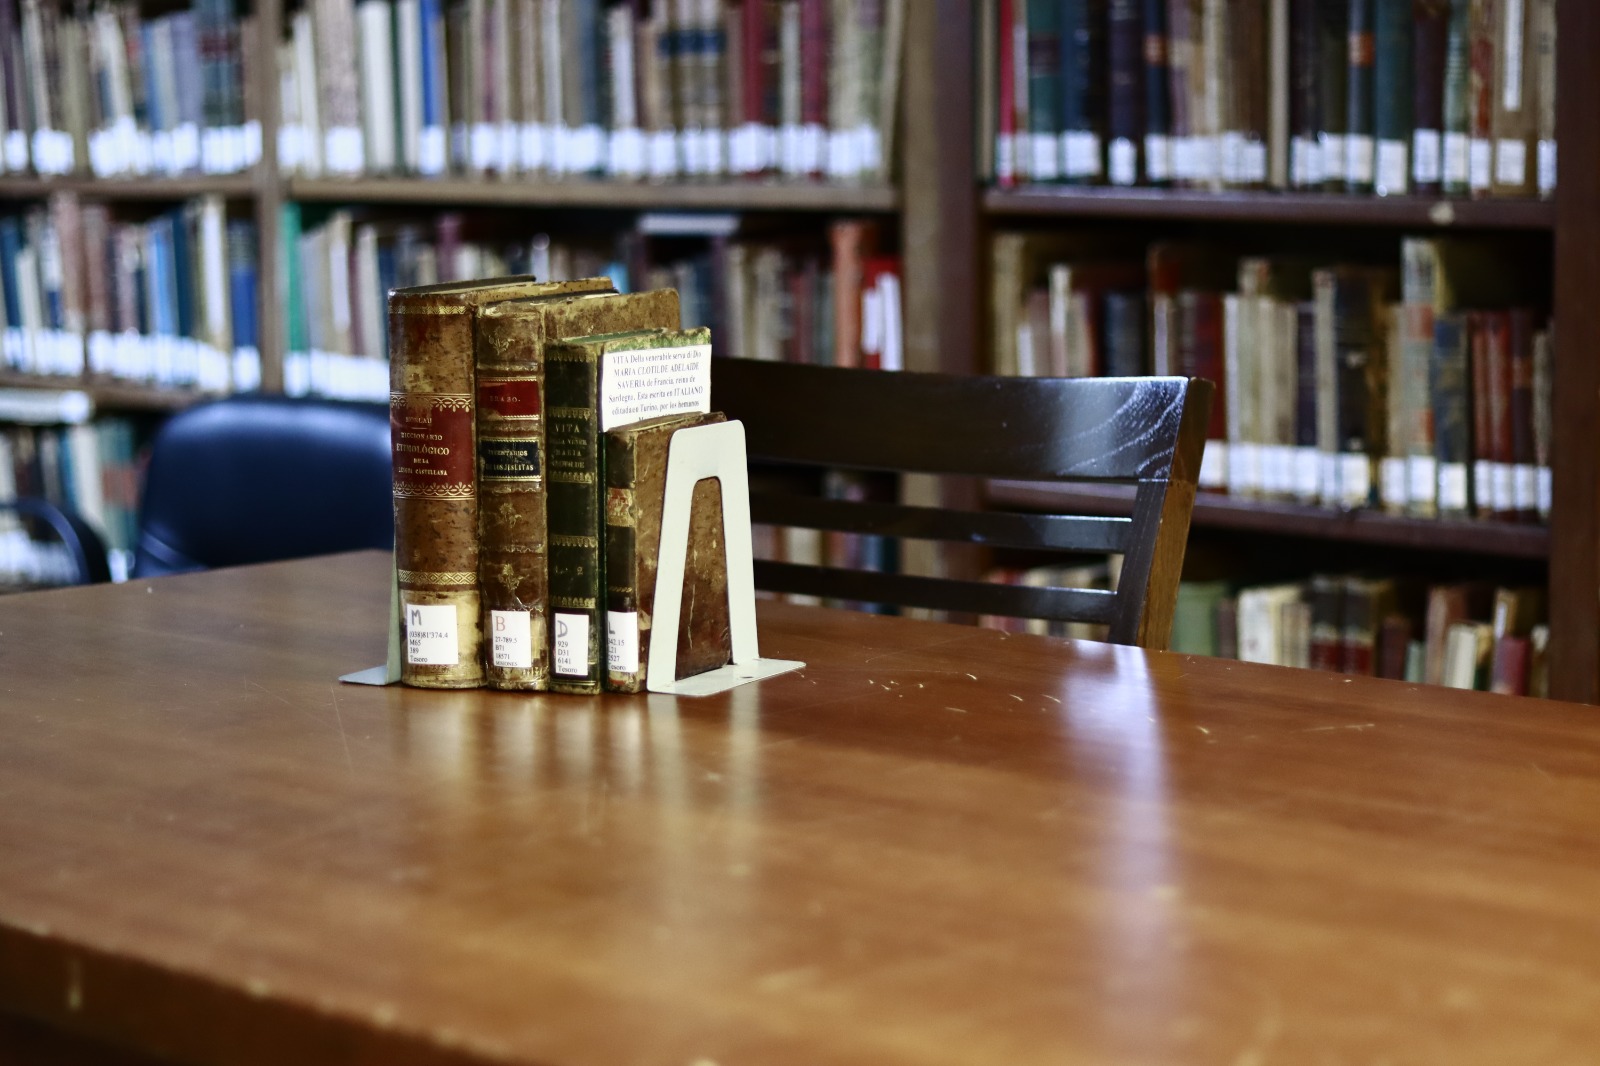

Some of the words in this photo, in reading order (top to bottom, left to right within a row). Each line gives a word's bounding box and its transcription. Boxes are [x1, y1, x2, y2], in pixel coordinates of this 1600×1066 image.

[613, 355, 629, 364] VITA
[630, 354, 645, 364] Della
[645, 352, 672, 362] venerabile
[672, 352, 686, 360] serva
[638, 364, 668, 376] CLOTILDE
[670, 362, 700, 372] ADELAIDE
[618, 380, 646, 389] SAVERIA
[638, 392, 648, 400] Esta
[649, 390, 666, 398] escrita
[674, 386, 703, 396] ITALIANO
[660, 402, 668, 412] por
[555, 424, 580, 433] VITA
[411, 609, 422, 626] M
[495, 616, 506, 631] B
[557, 620, 568, 638] D
